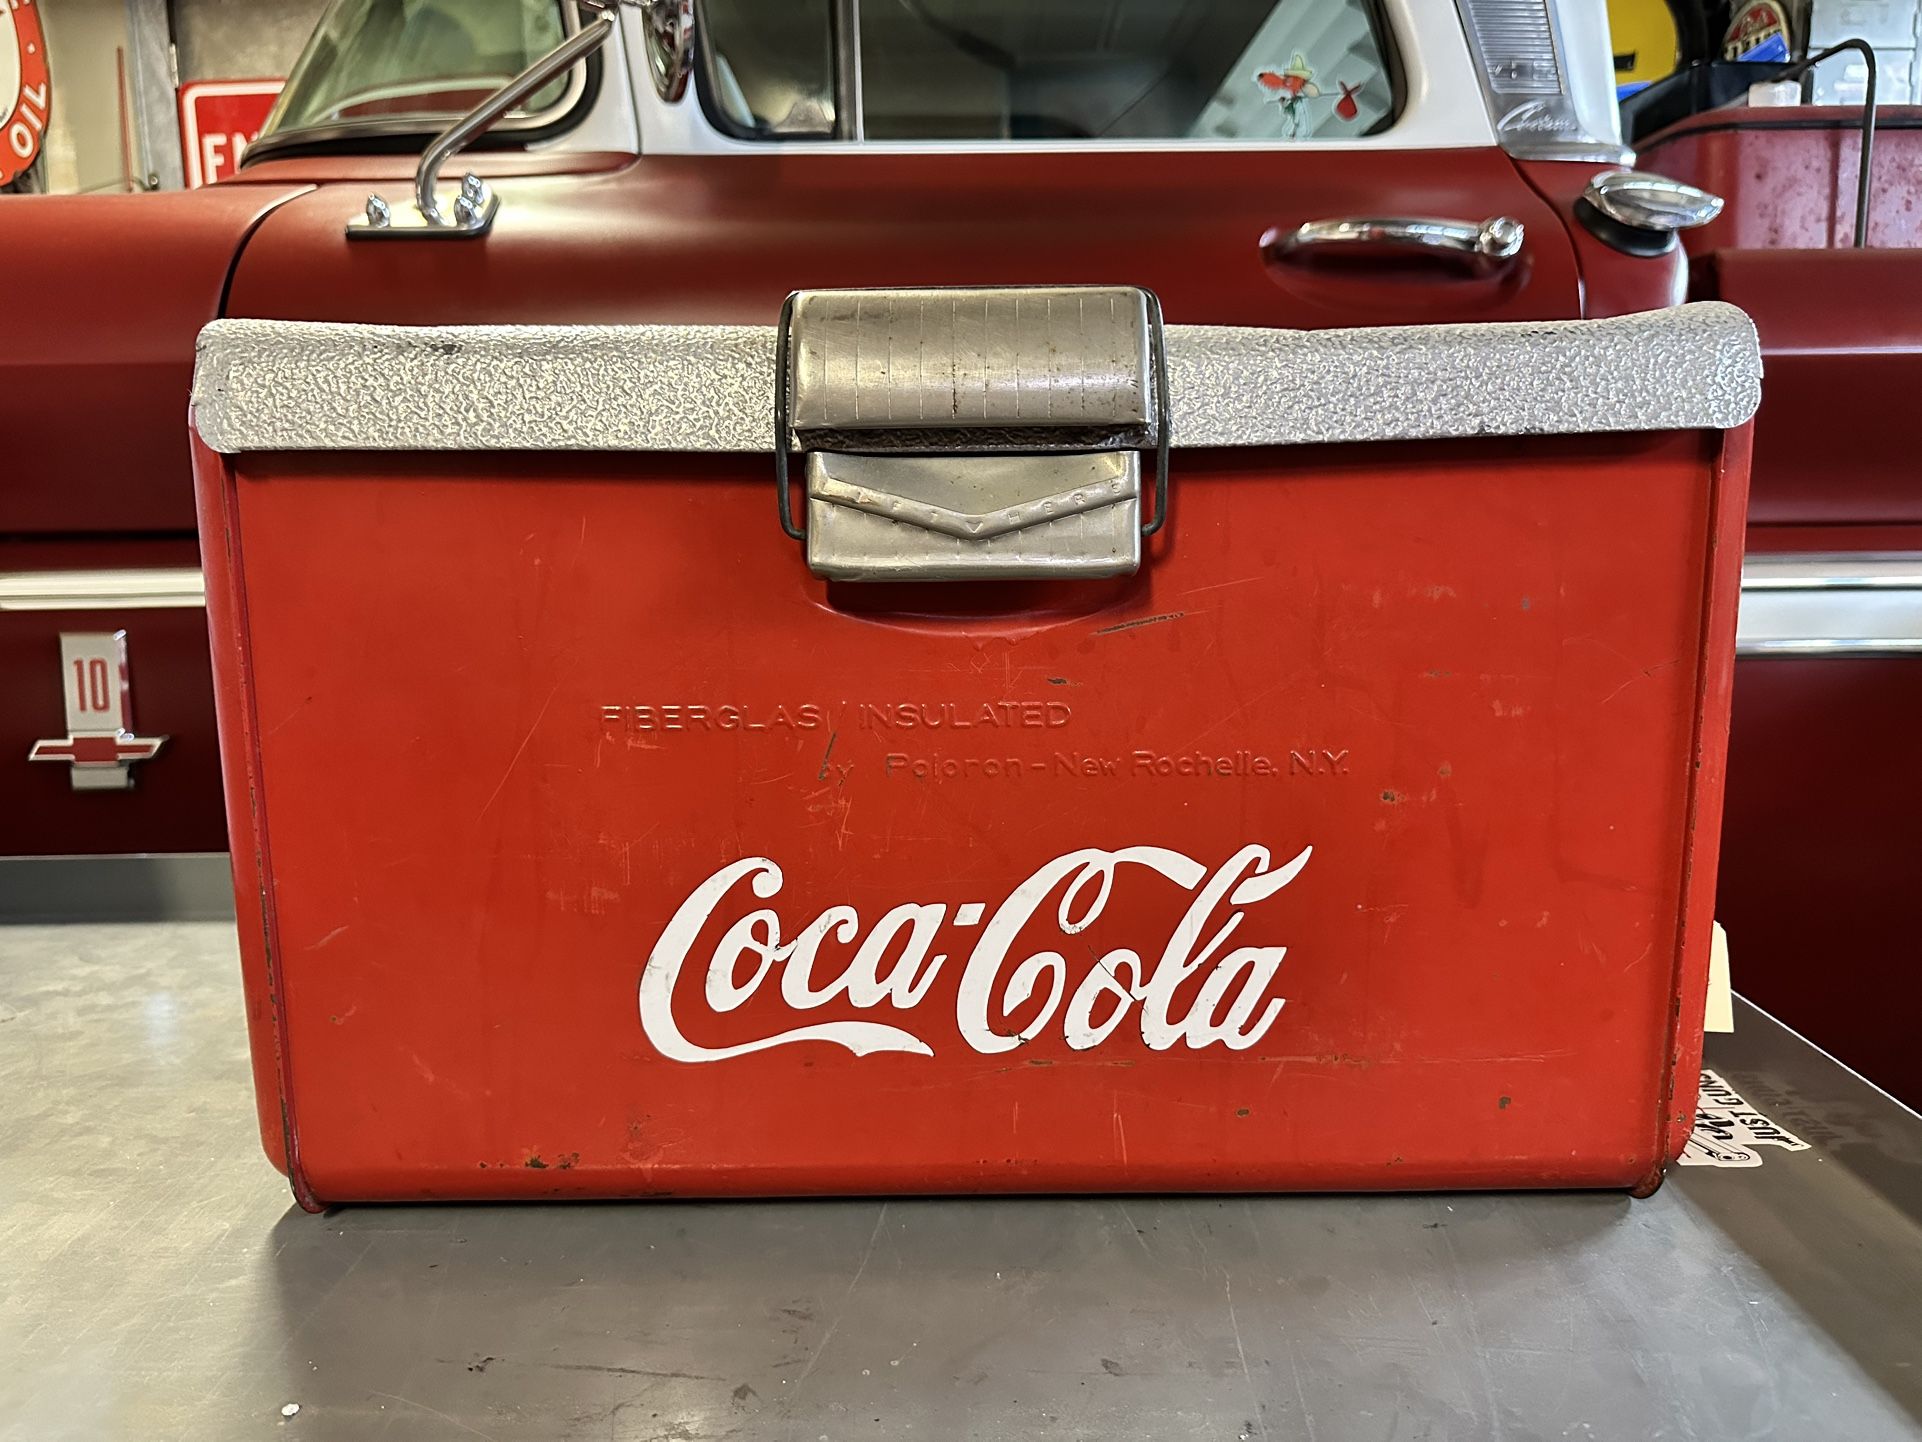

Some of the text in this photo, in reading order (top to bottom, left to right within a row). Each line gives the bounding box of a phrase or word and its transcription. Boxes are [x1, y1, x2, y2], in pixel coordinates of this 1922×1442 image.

[9, 82, 47, 158] OIL
[73, 657, 110, 713] 10
[599, 701, 1072, 733] FIBERGLAS INSULATED
[1289, 749, 1350, 777] N.Y.
[639, 843, 1314, 1064] Coca-Cola
[1728, 1110, 1794, 1146] JUST
